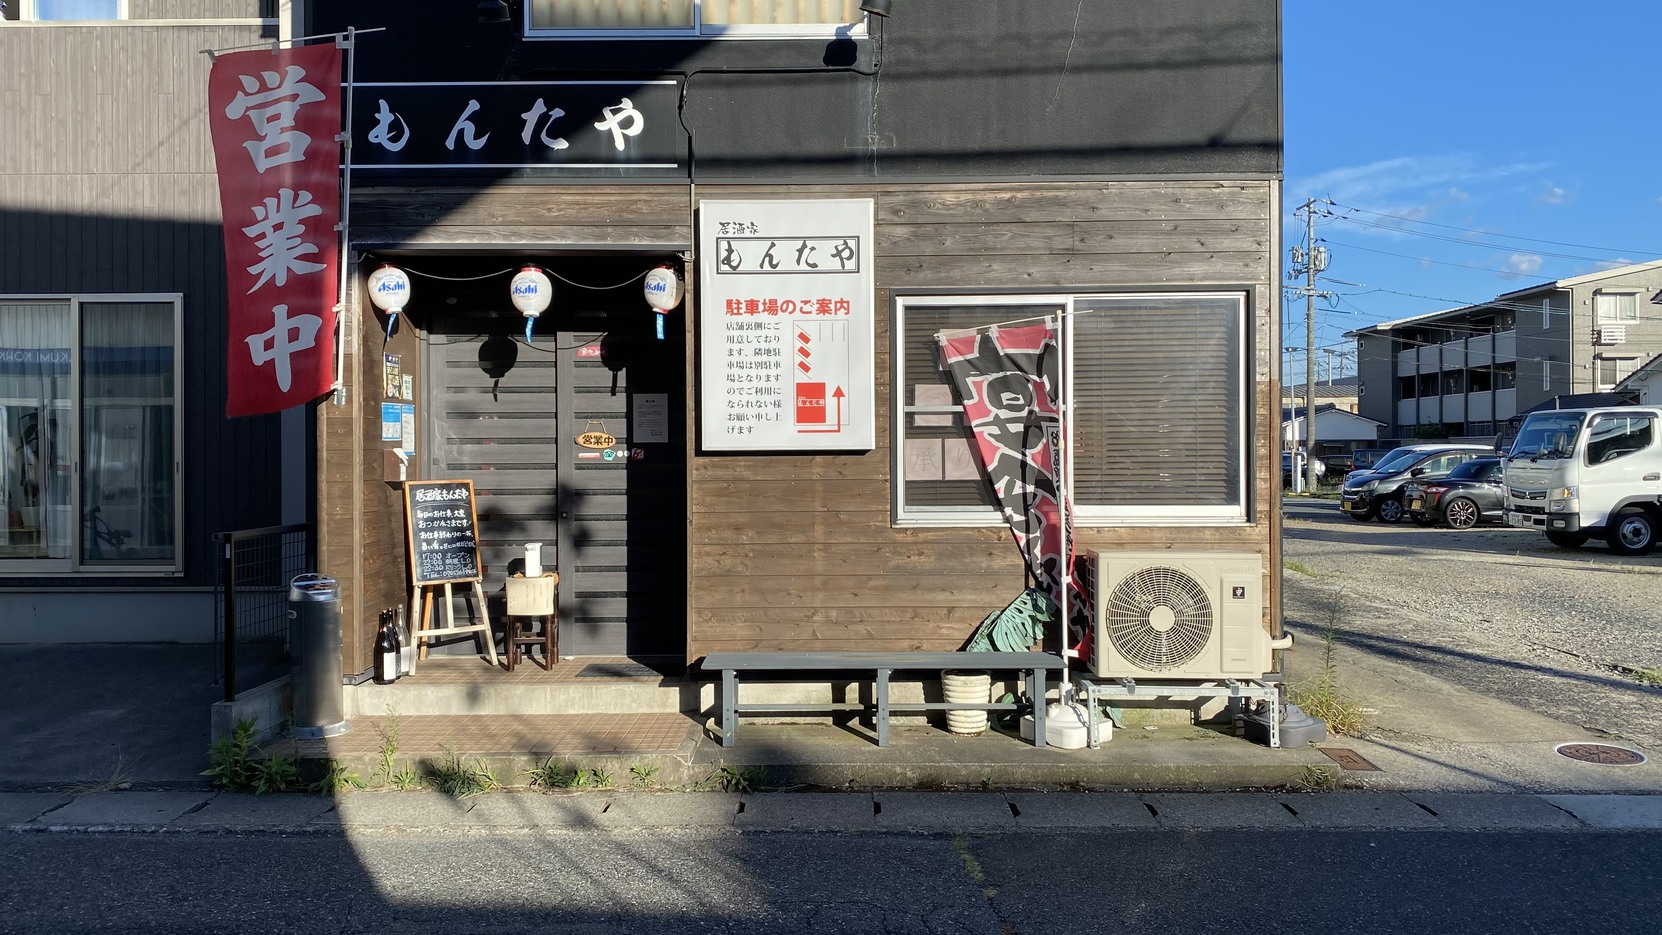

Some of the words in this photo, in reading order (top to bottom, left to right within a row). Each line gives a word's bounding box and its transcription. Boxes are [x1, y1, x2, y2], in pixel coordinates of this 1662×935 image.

[368, 98, 644, 151] もんたや
[225, 65, 327, 393] 営業中
[717, 221, 760, 235] 居酒家
[721, 239, 855, 271] もんたや
[377, 281, 406, 293] Asahi
[512, 284, 538, 295] Asahi
[725, 298, 851, 316] 駐車場のご案内
[726, 321, 781, 331] 店舗裏側にご
[726, 335, 780, 344] 用意しており
[727, 348, 781, 357] ます、隣地駐
[727, 361, 781, 370] 車場は別駐車
[726, 374, 781, 383] 場となります
[726, 387, 781, 396] のでご利用に
[726, 400, 782, 408] なられない様
[727, 413, 782, 421] お願い申し上
[727, 426, 754, 434] げます
[582, 434, 613, 446] 営業中
